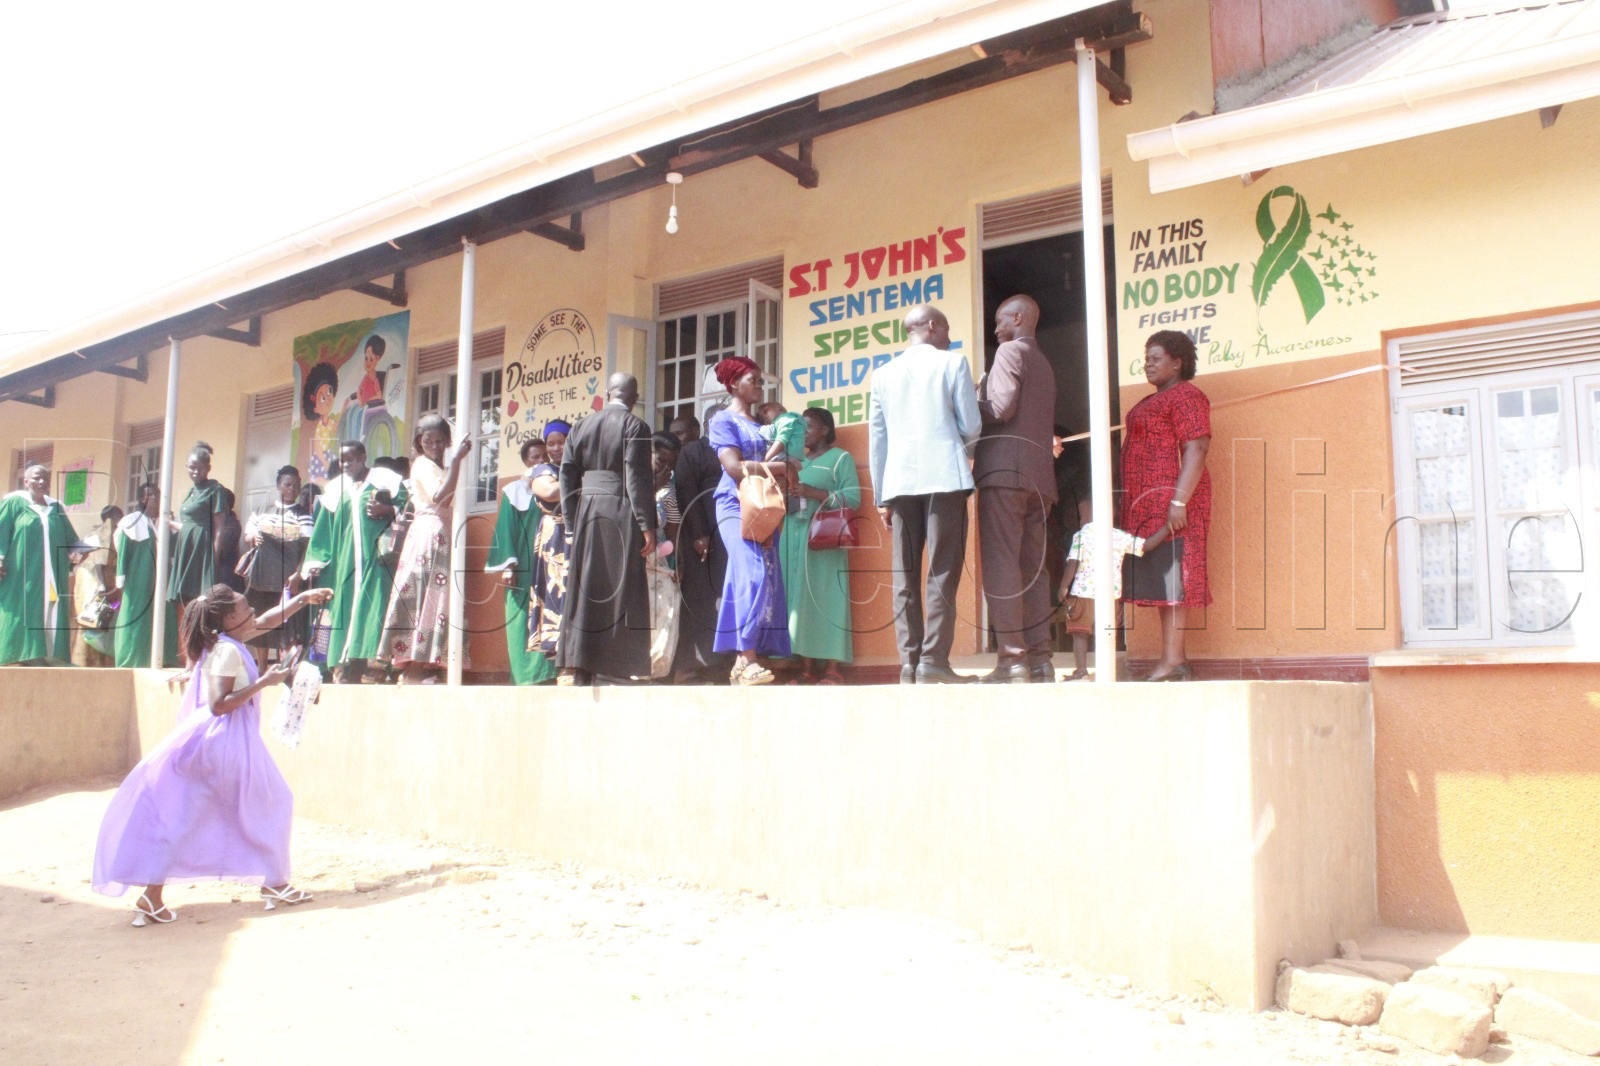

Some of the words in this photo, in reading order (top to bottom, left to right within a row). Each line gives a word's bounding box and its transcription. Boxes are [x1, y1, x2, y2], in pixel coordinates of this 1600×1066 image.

[1129, 228, 1151, 251] IN
[1157, 218, 1204, 245] THIS
[788, 258, 833, 298] S.T
[843, 226, 967, 289] JOHN'S
[1132, 240, 1207, 274] FAMILY
[809, 273, 944, 327] SENTEMA
[1122, 277, 1159, 310] NO
[1164, 262, 1240, 304] BODY
[526, 323, 548, 352] SOME
[549, 312, 567, 328] SEE
[570, 313, 587, 335] THE
[1138, 302, 1217, 329] FIGHTS
[813, 318, 909, 358] SPECI
[1251, 333, 1353, 359] Awareness
[505, 350, 603, 393] Disabilities
[532, 395, 536, 407] I
[538, 391, 555, 406] SEE
[559, 386, 578, 402] THE
